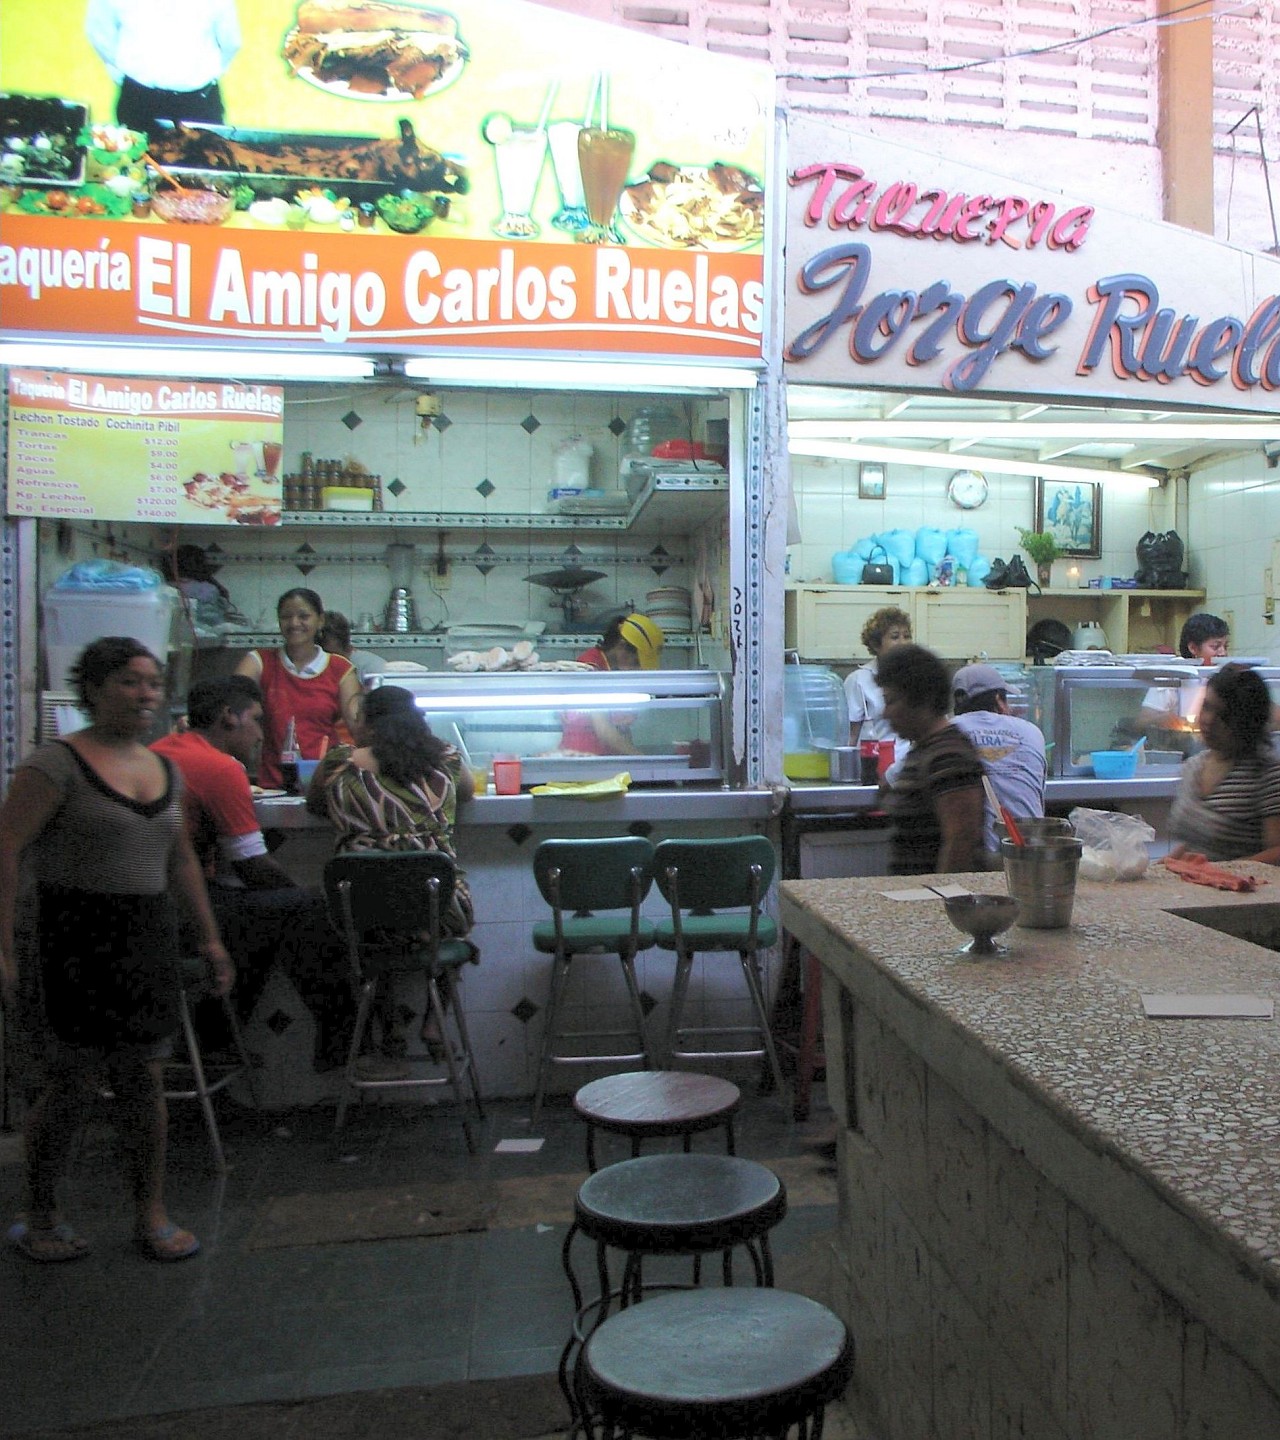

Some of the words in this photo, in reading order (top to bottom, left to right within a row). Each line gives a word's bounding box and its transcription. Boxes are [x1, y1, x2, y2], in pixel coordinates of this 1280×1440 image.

[0, 237, 131, 300] aquería
[138, 236, 191, 318] El
[210, 247, 387, 343] Amigo
[404, 249, 577, 326] Carlos
[594, 247, 763, 334] Ruelas
[783, 241, 1073, 391] Jorge
[69, 379, 88, 405] El
[93, 383, 152, 415] Amigo
[158, 386, 217, 411] Carlos
[222, 385, 281, 413] Ruelas
[58, 414, 100, 428] Tostado
[106, 418, 155, 432] Cochinita
[158, 420, 180, 433] Pibil
[17, 429, 68, 440] Trancas
[144, 438, 178, 446] $12.00
[17, 441, 58, 451] Tortas
[17, 453, 54, 463] Tacos
[17, 466, 55, 476] Aguas
[17, 478, 79, 489] Refrescos
[41, 504, 94, 515] Especial
